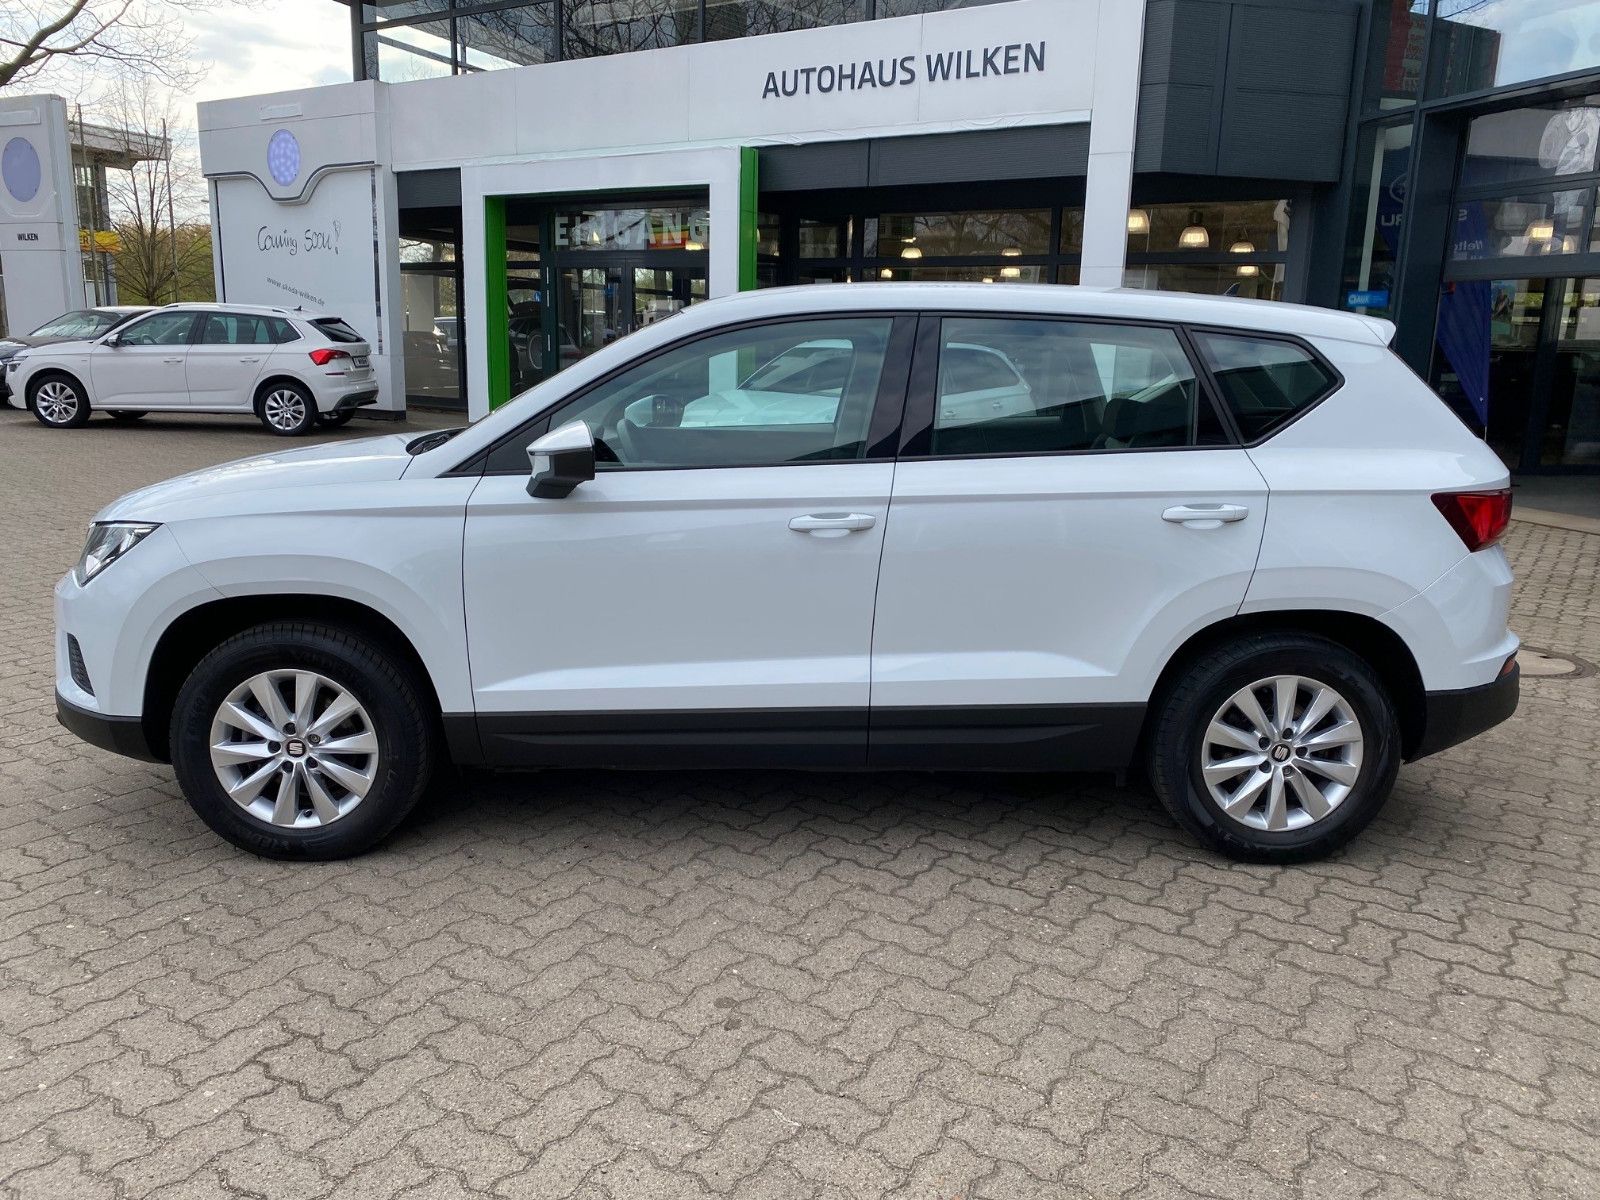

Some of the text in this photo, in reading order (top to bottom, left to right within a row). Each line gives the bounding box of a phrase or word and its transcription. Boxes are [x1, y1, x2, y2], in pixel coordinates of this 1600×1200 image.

[762, 41, 1046, 99] AUTOHAUS WILKEN
[17, 233, 38, 241] WILKEN
[257, 225, 298, 256] Coming
